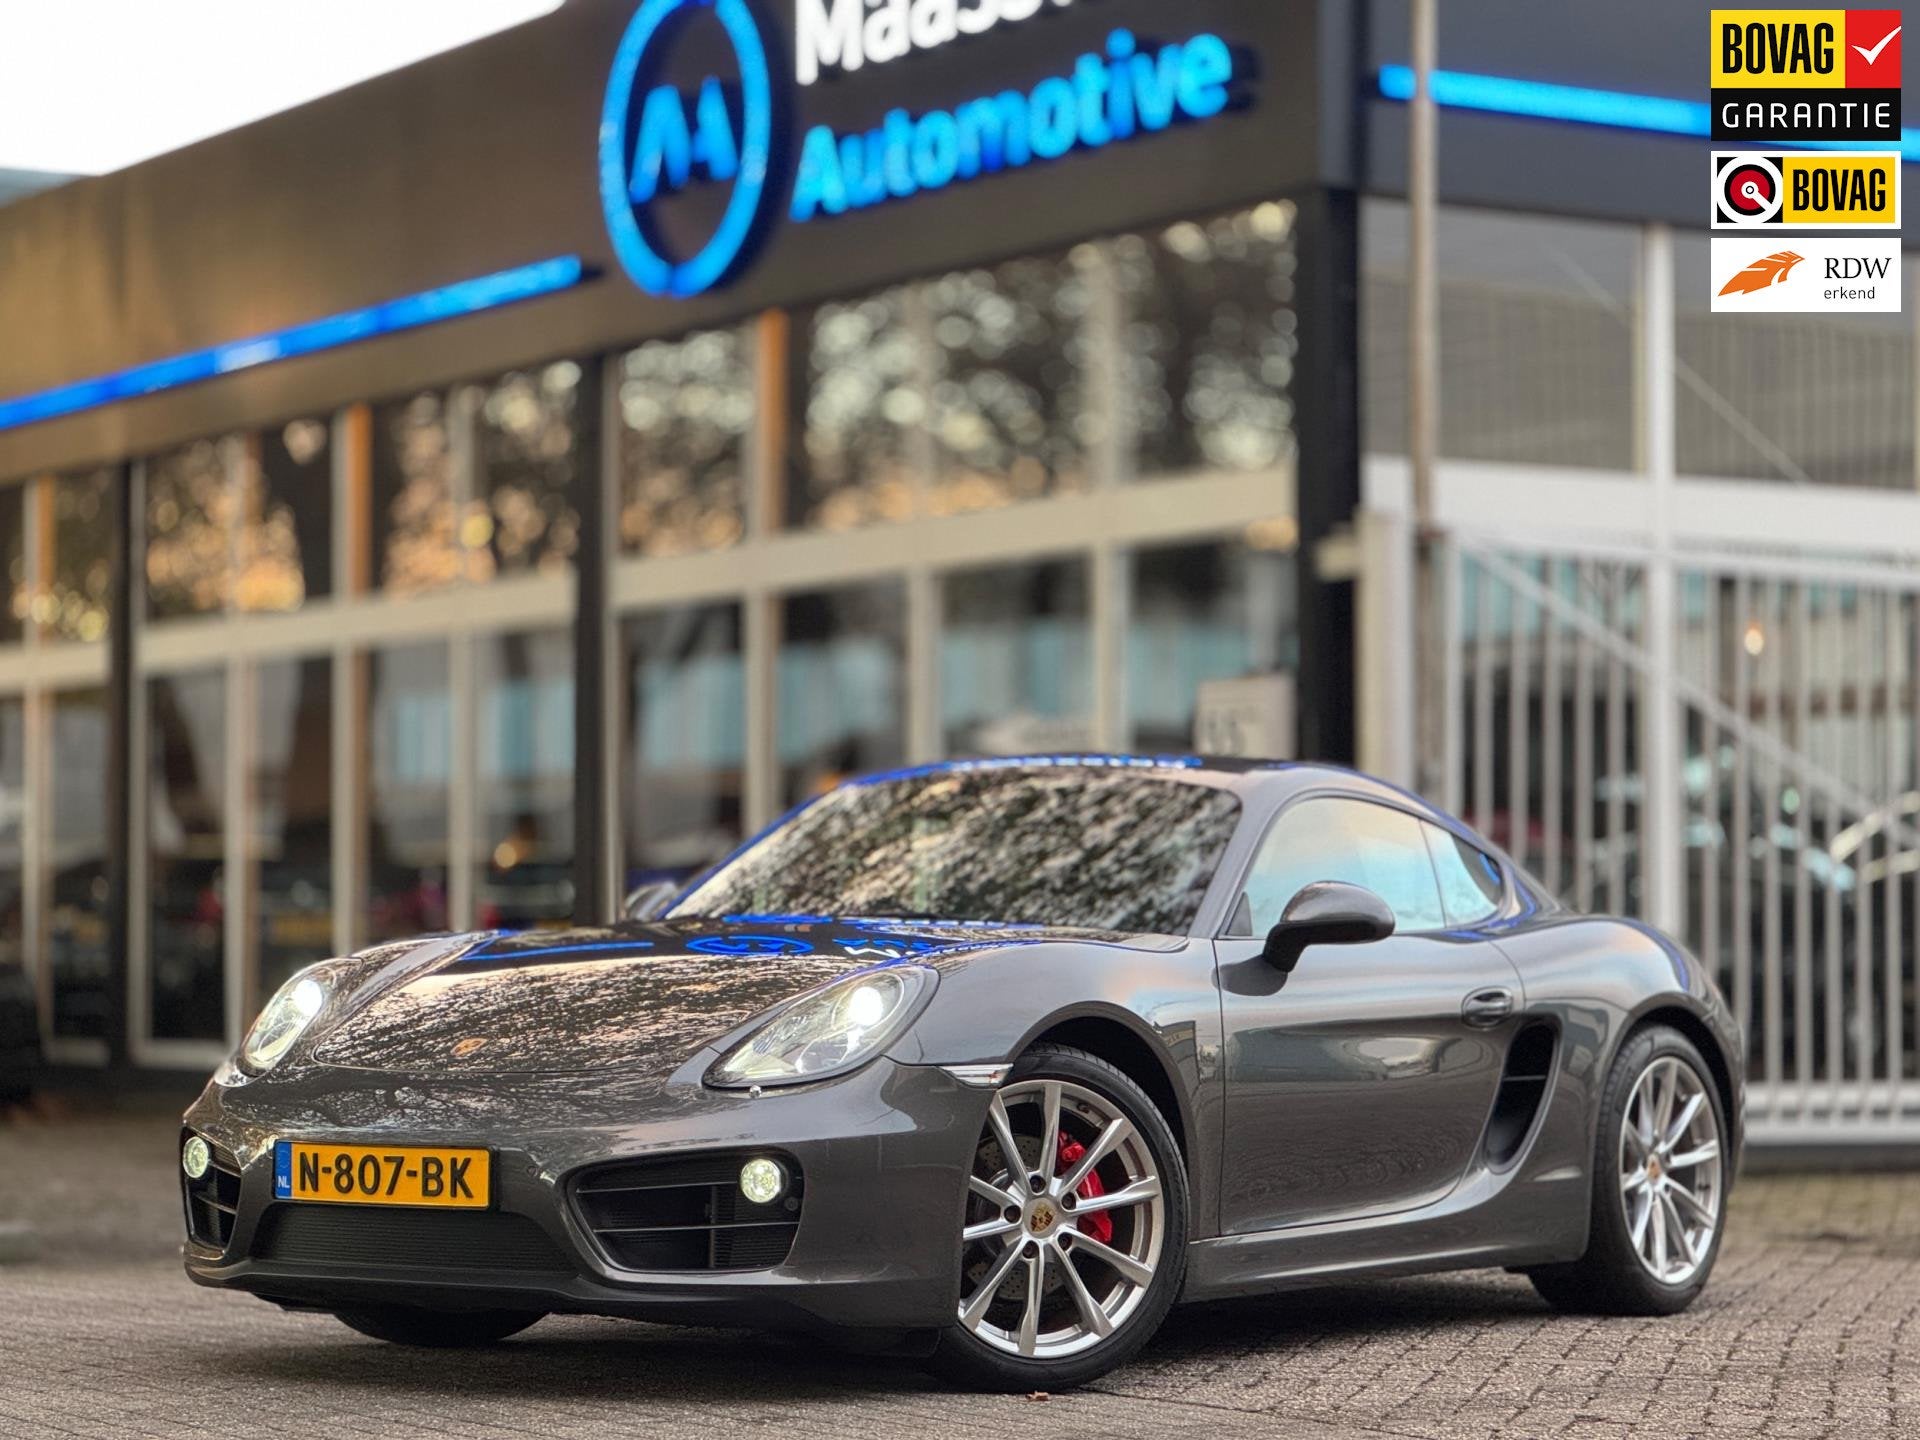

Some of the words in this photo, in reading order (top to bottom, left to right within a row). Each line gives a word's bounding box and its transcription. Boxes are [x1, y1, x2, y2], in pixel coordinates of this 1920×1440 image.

[790, 28, 1232, 222] Automotive
[278, 1175, 290, 1188] NL
[299, 1151, 474, 1199] N-807-BK
